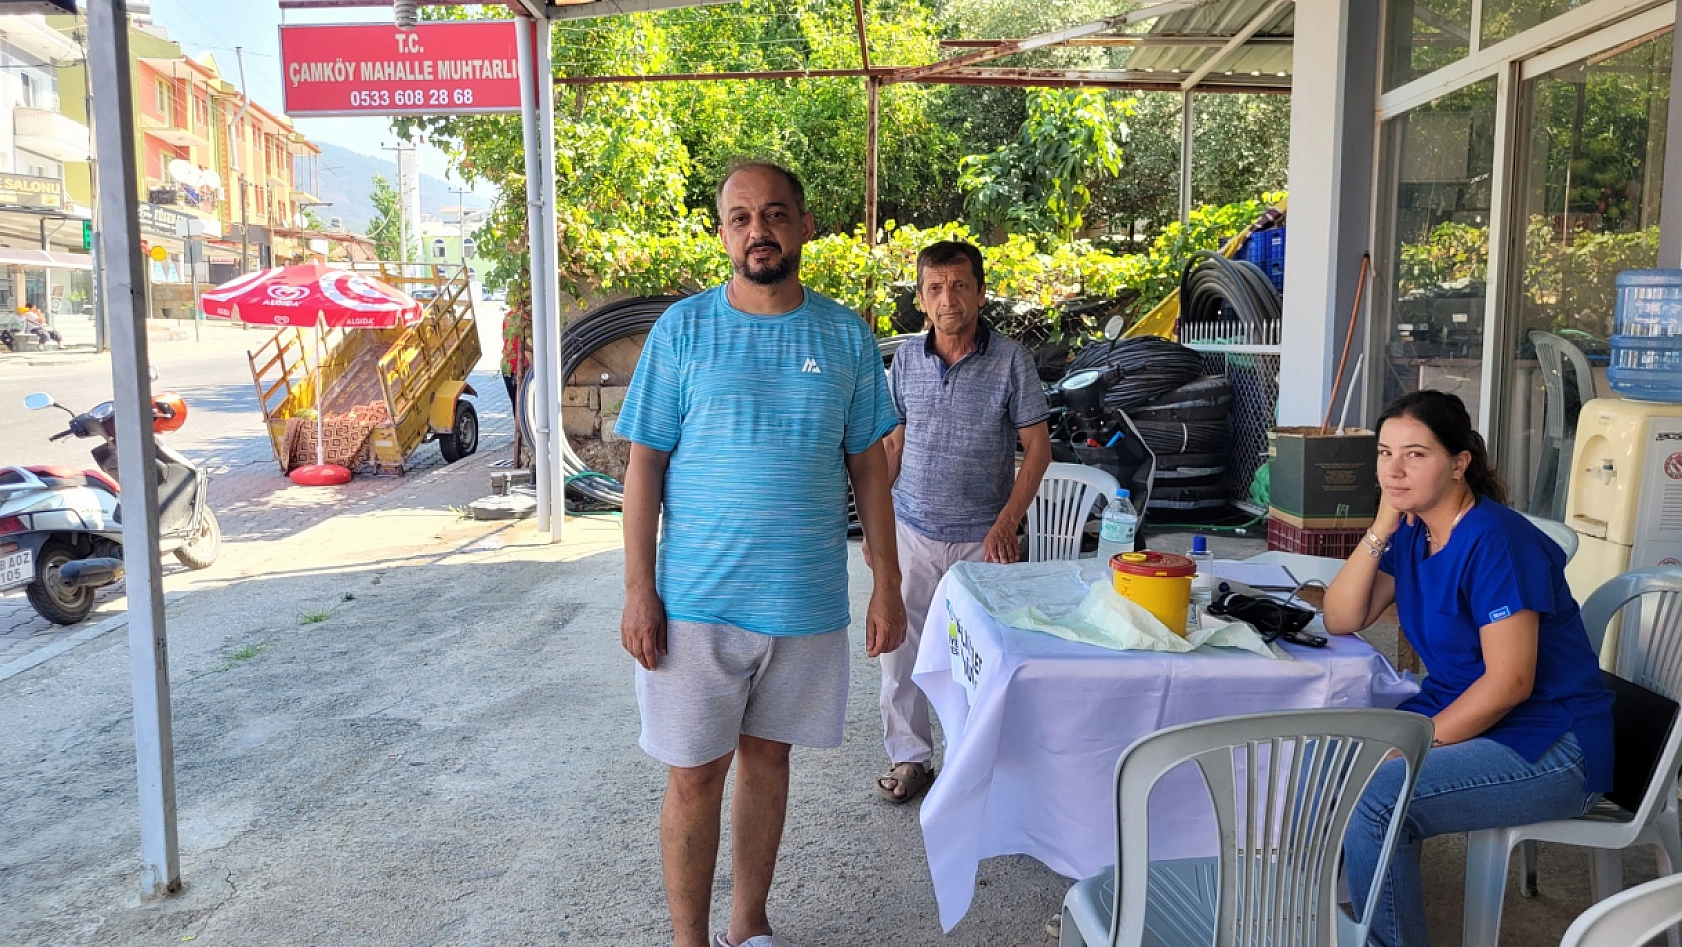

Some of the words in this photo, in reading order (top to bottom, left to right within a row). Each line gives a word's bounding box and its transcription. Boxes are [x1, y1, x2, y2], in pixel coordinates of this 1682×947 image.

[395, 33, 424, 53] T.C.
[289, 58, 356, 87] ÇAMKÖY
[361, 61, 434, 82] MAHALLE
[438, 59, 518, 80] MUHTARLI
[350, 90, 390, 106] 0533
[394, 90, 424, 106] 608
[429, 89, 449, 105] 28
[453, 89, 474, 104] 68
[4, 178, 61, 194] SALONU
